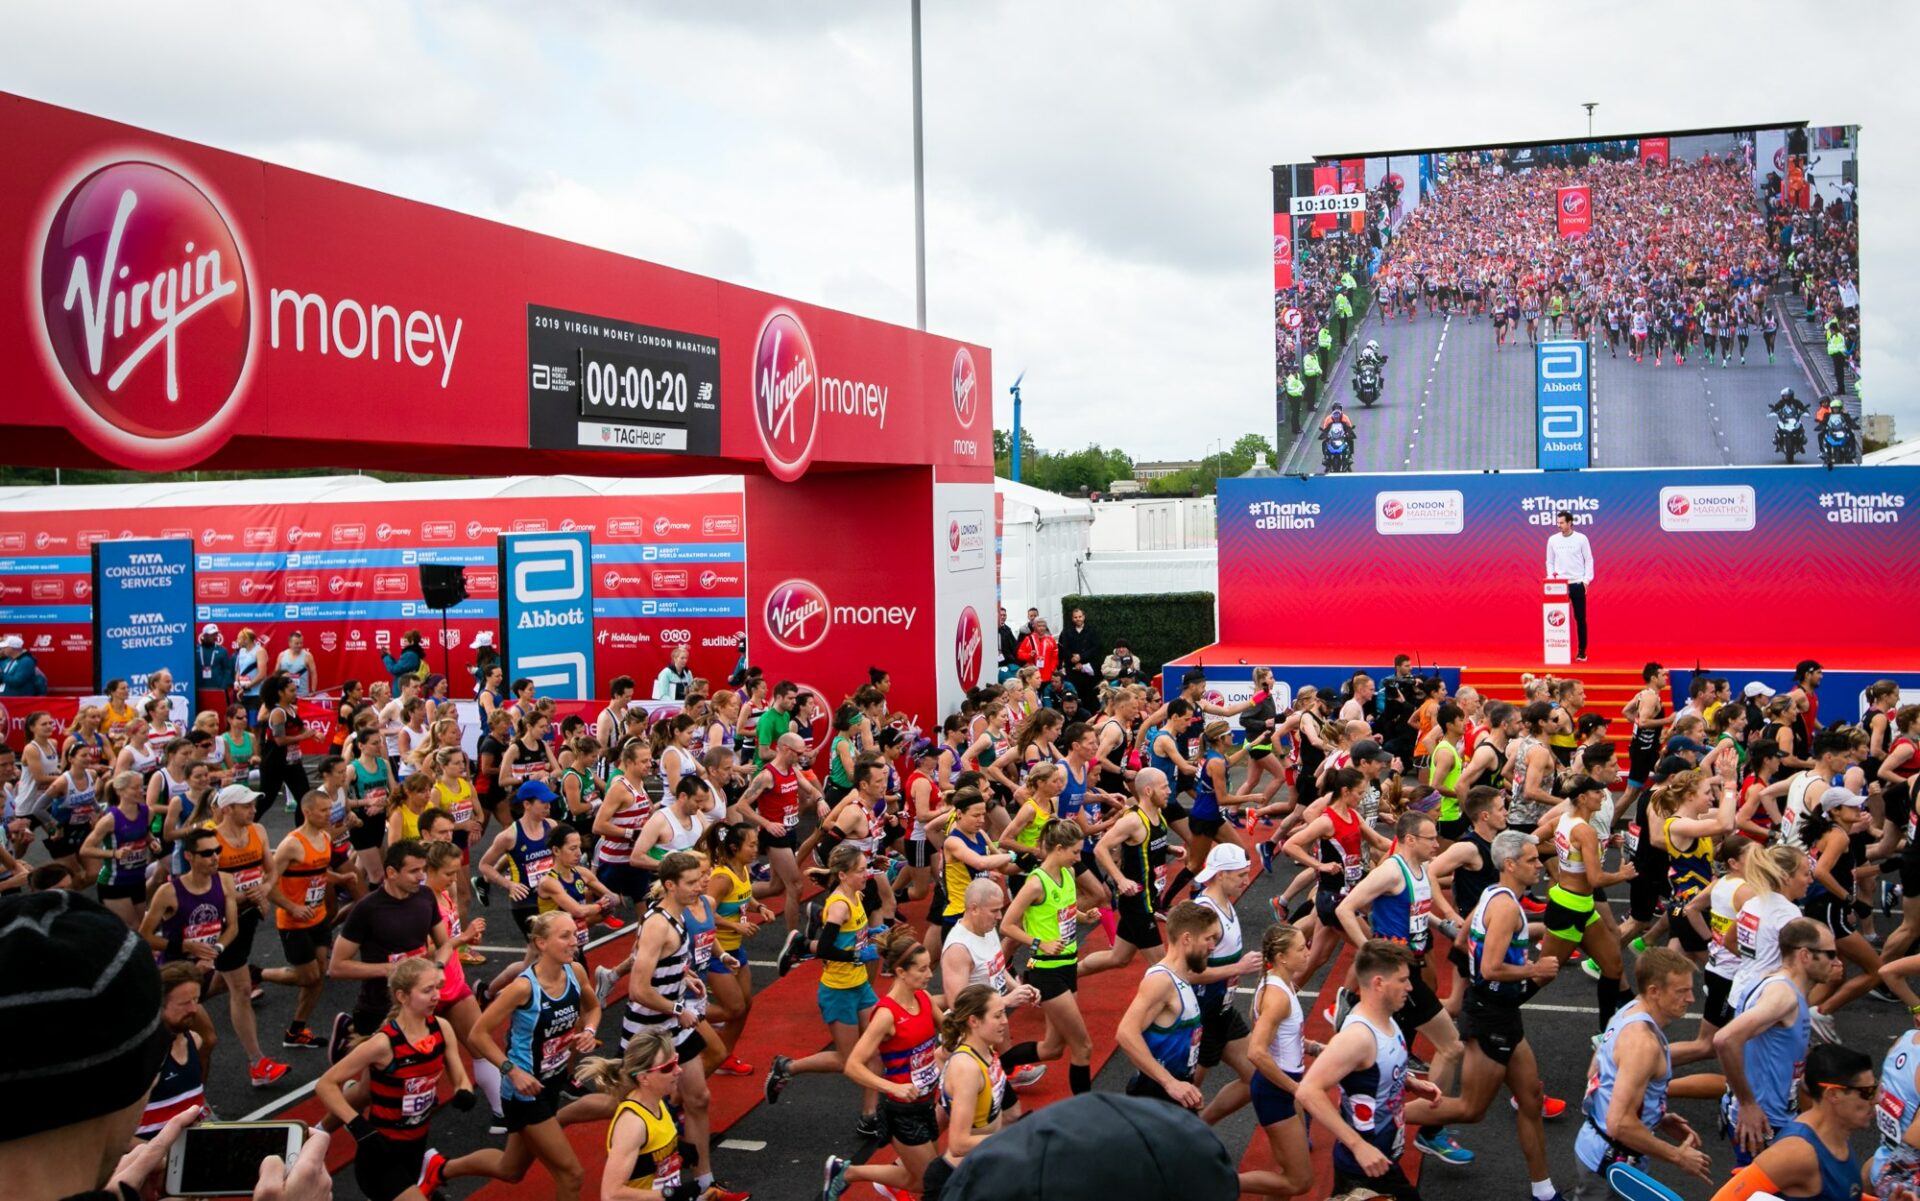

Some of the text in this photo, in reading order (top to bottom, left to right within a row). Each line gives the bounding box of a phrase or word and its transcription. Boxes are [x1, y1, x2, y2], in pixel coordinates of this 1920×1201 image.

[1297, 197, 1359, 212] 10:10:19
[1563, 217, 1587, 225] money
[64, 189, 462, 402] Virgin money
[535, 316, 717, 356] 2019 VIRGIN MONEY LONDON MARATHON
[587, 361, 687, 413] 00:00:20
[761, 330, 888, 444] Virgin money
[954, 358, 975, 415] Virgin
[1543, 382, 1582, 392] Abbott
[954, 438, 977, 459] money
[1544, 442, 1583, 452] Abbott
[1406, 501, 1445, 510] LONDON
[1521, 496, 1599, 511] #Thanks
[1693, 497, 1735, 505] LONDON
[1819, 491, 1904, 508] #Thanks
[1249, 500, 1320, 516] #Thanks
[1406, 509, 1457, 518] MARATHON
[1693, 505, 1748, 514] MARATHON
[1827, 507, 1898, 523] aBillion
[671, 522, 691, 530] money
[1255, 515, 1315, 530] aBillion
[961, 525, 978, 535] LONDON
[129, 554, 164, 564] TATA
[105, 564, 187, 578] CONSULTANCY
[121, 577, 172, 589] SERVICES
[621, 576, 641, 584] money
[717, 576, 738, 584] money
[129, 613, 165, 625] TATA
[517, 608, 585, 629] Abbott
[773, 589, 917, 639] Virgin money
[106, 623, 187, 639] CONSULTANCY
[611, 632, 650, 643] Holiday Inn
[661, 629, 691, 643] TNT
[122, 636, 173, 649] SERVICES
[702, 635, 737, 646] audible
[958, 616, 981, 682] Virgin
[554, 1005, 575, 1018] POOLE
